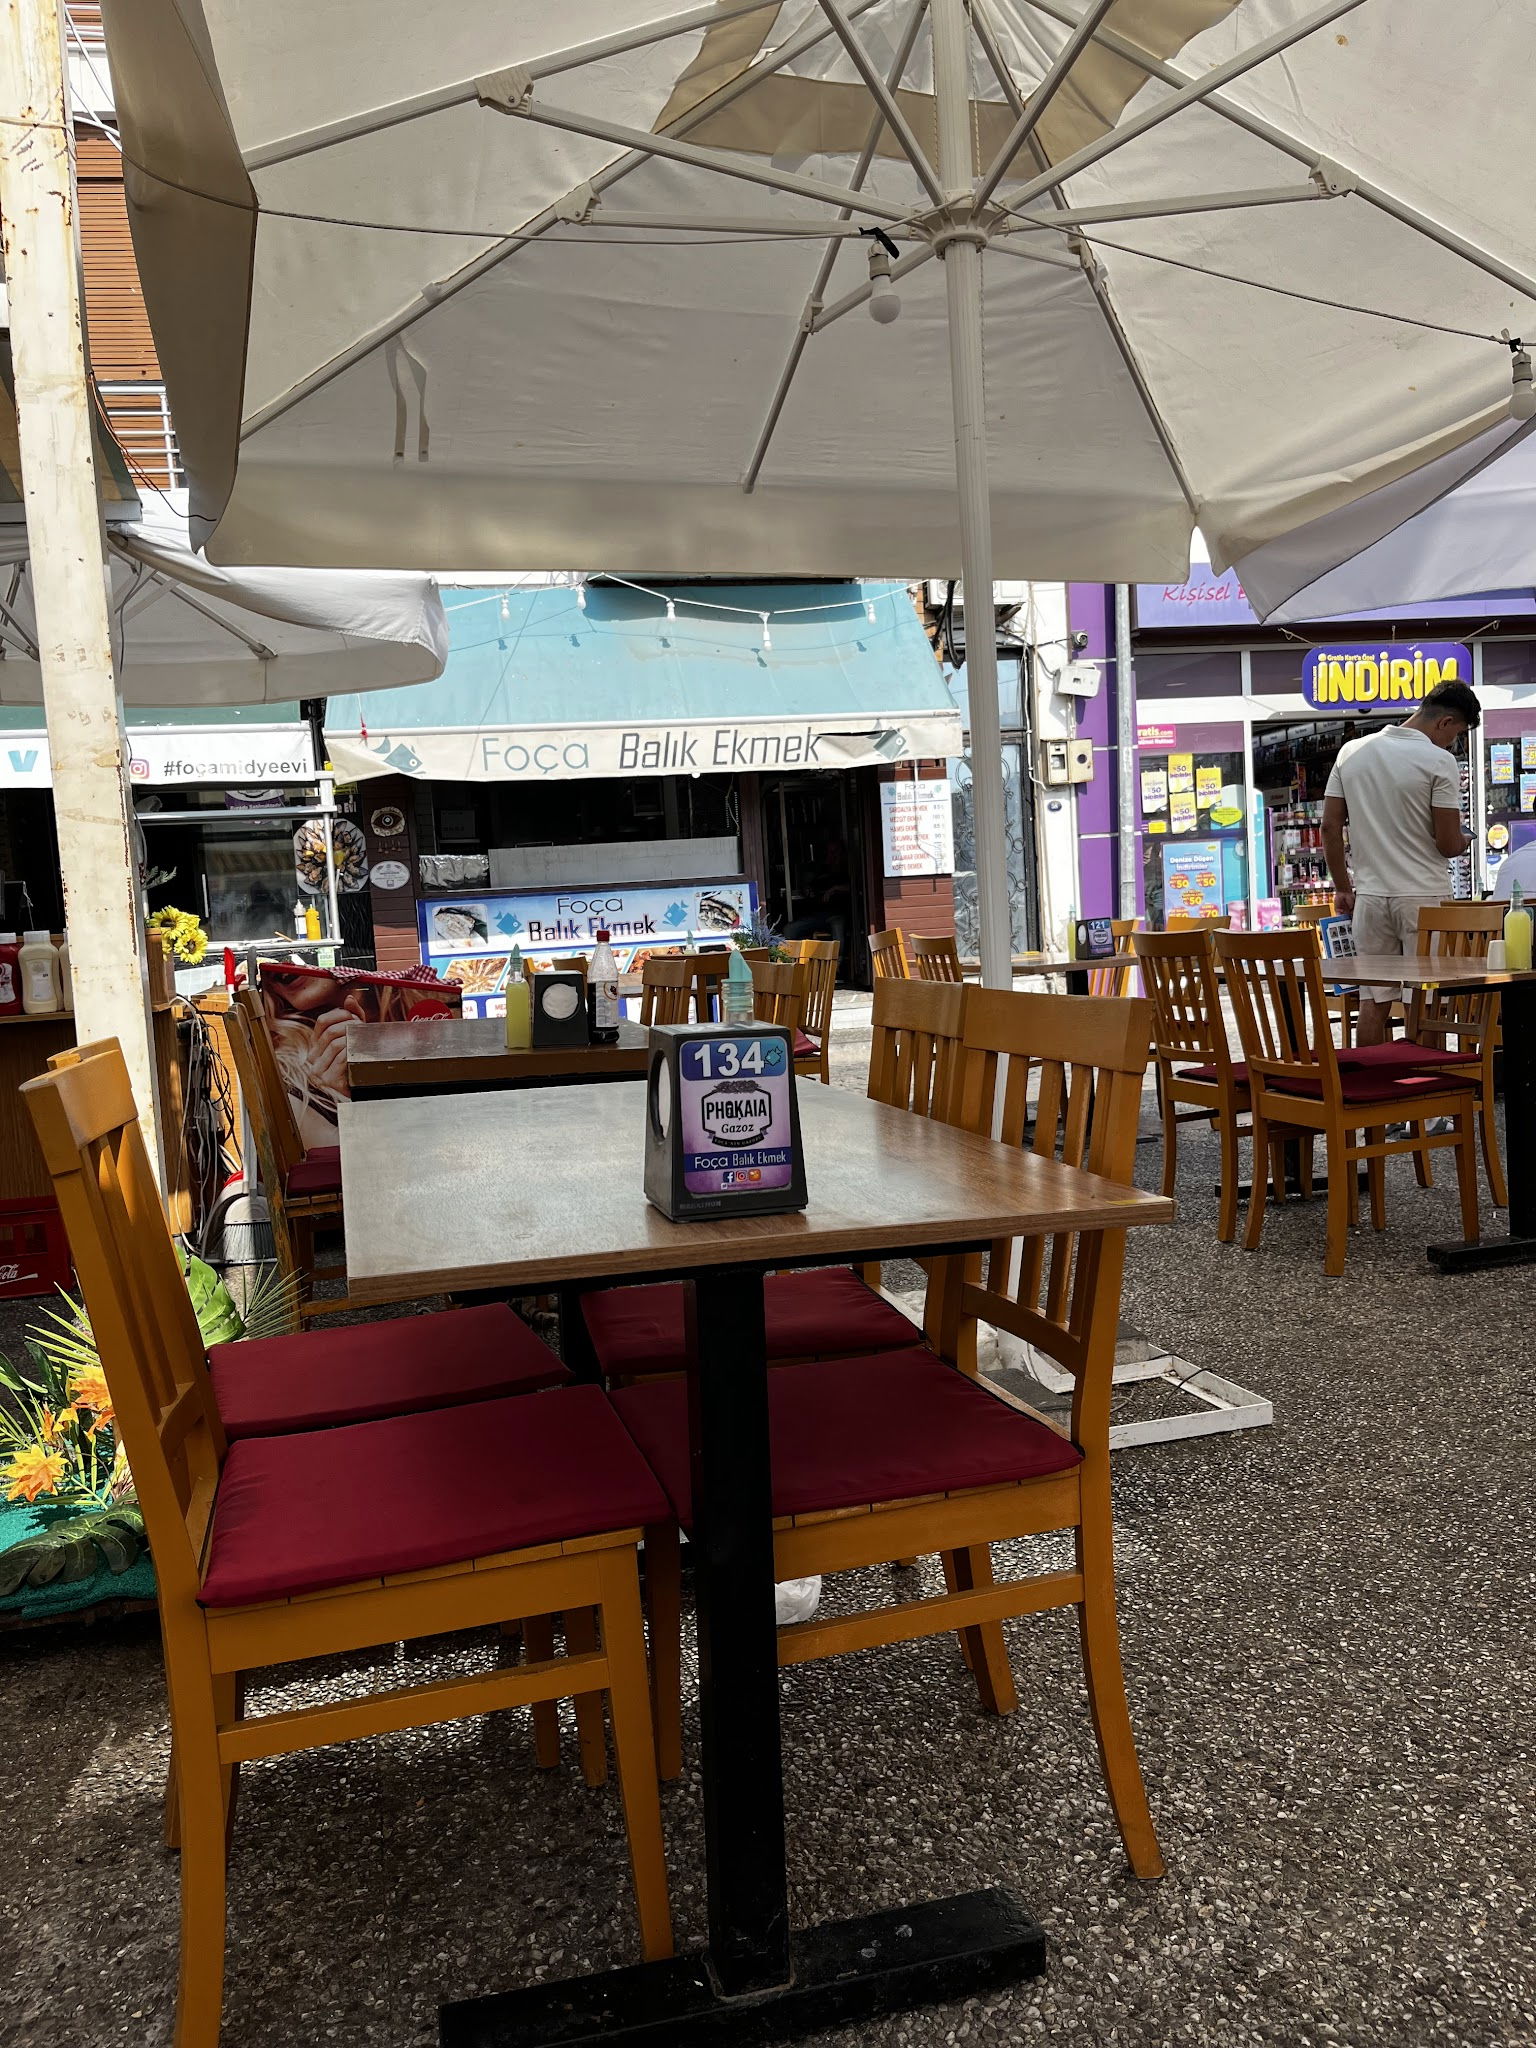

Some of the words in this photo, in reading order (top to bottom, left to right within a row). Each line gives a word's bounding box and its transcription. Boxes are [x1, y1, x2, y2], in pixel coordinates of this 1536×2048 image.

[1163, 582, 1230, 607] Kişisel
[1137, 726, 1173, 737] ratis.com
[482, 737, 590, 774] Foça
[619, 731, 699, 769] Balık
[712, 726, 823, 766] Ekmek
[164, 758, 308, 779] #foçamidyeevi
[557, 897, 623, 915] Foça
[528, 918, 582, 941] Balık
[588, 914, 657, 938] Ekmek
[1091, 920, 1105, 930] 121
[694, 1041, 765, 1078] 134
[706, 1099, 767, 1120] PHOKAIA
[721, 1123, 754, 1134] Gazoz
[694, 1156, 729, 1170] Foça
[732, 1152, 755, 1167] Balık
[757, 1150, 787, 1165] Ekmek
